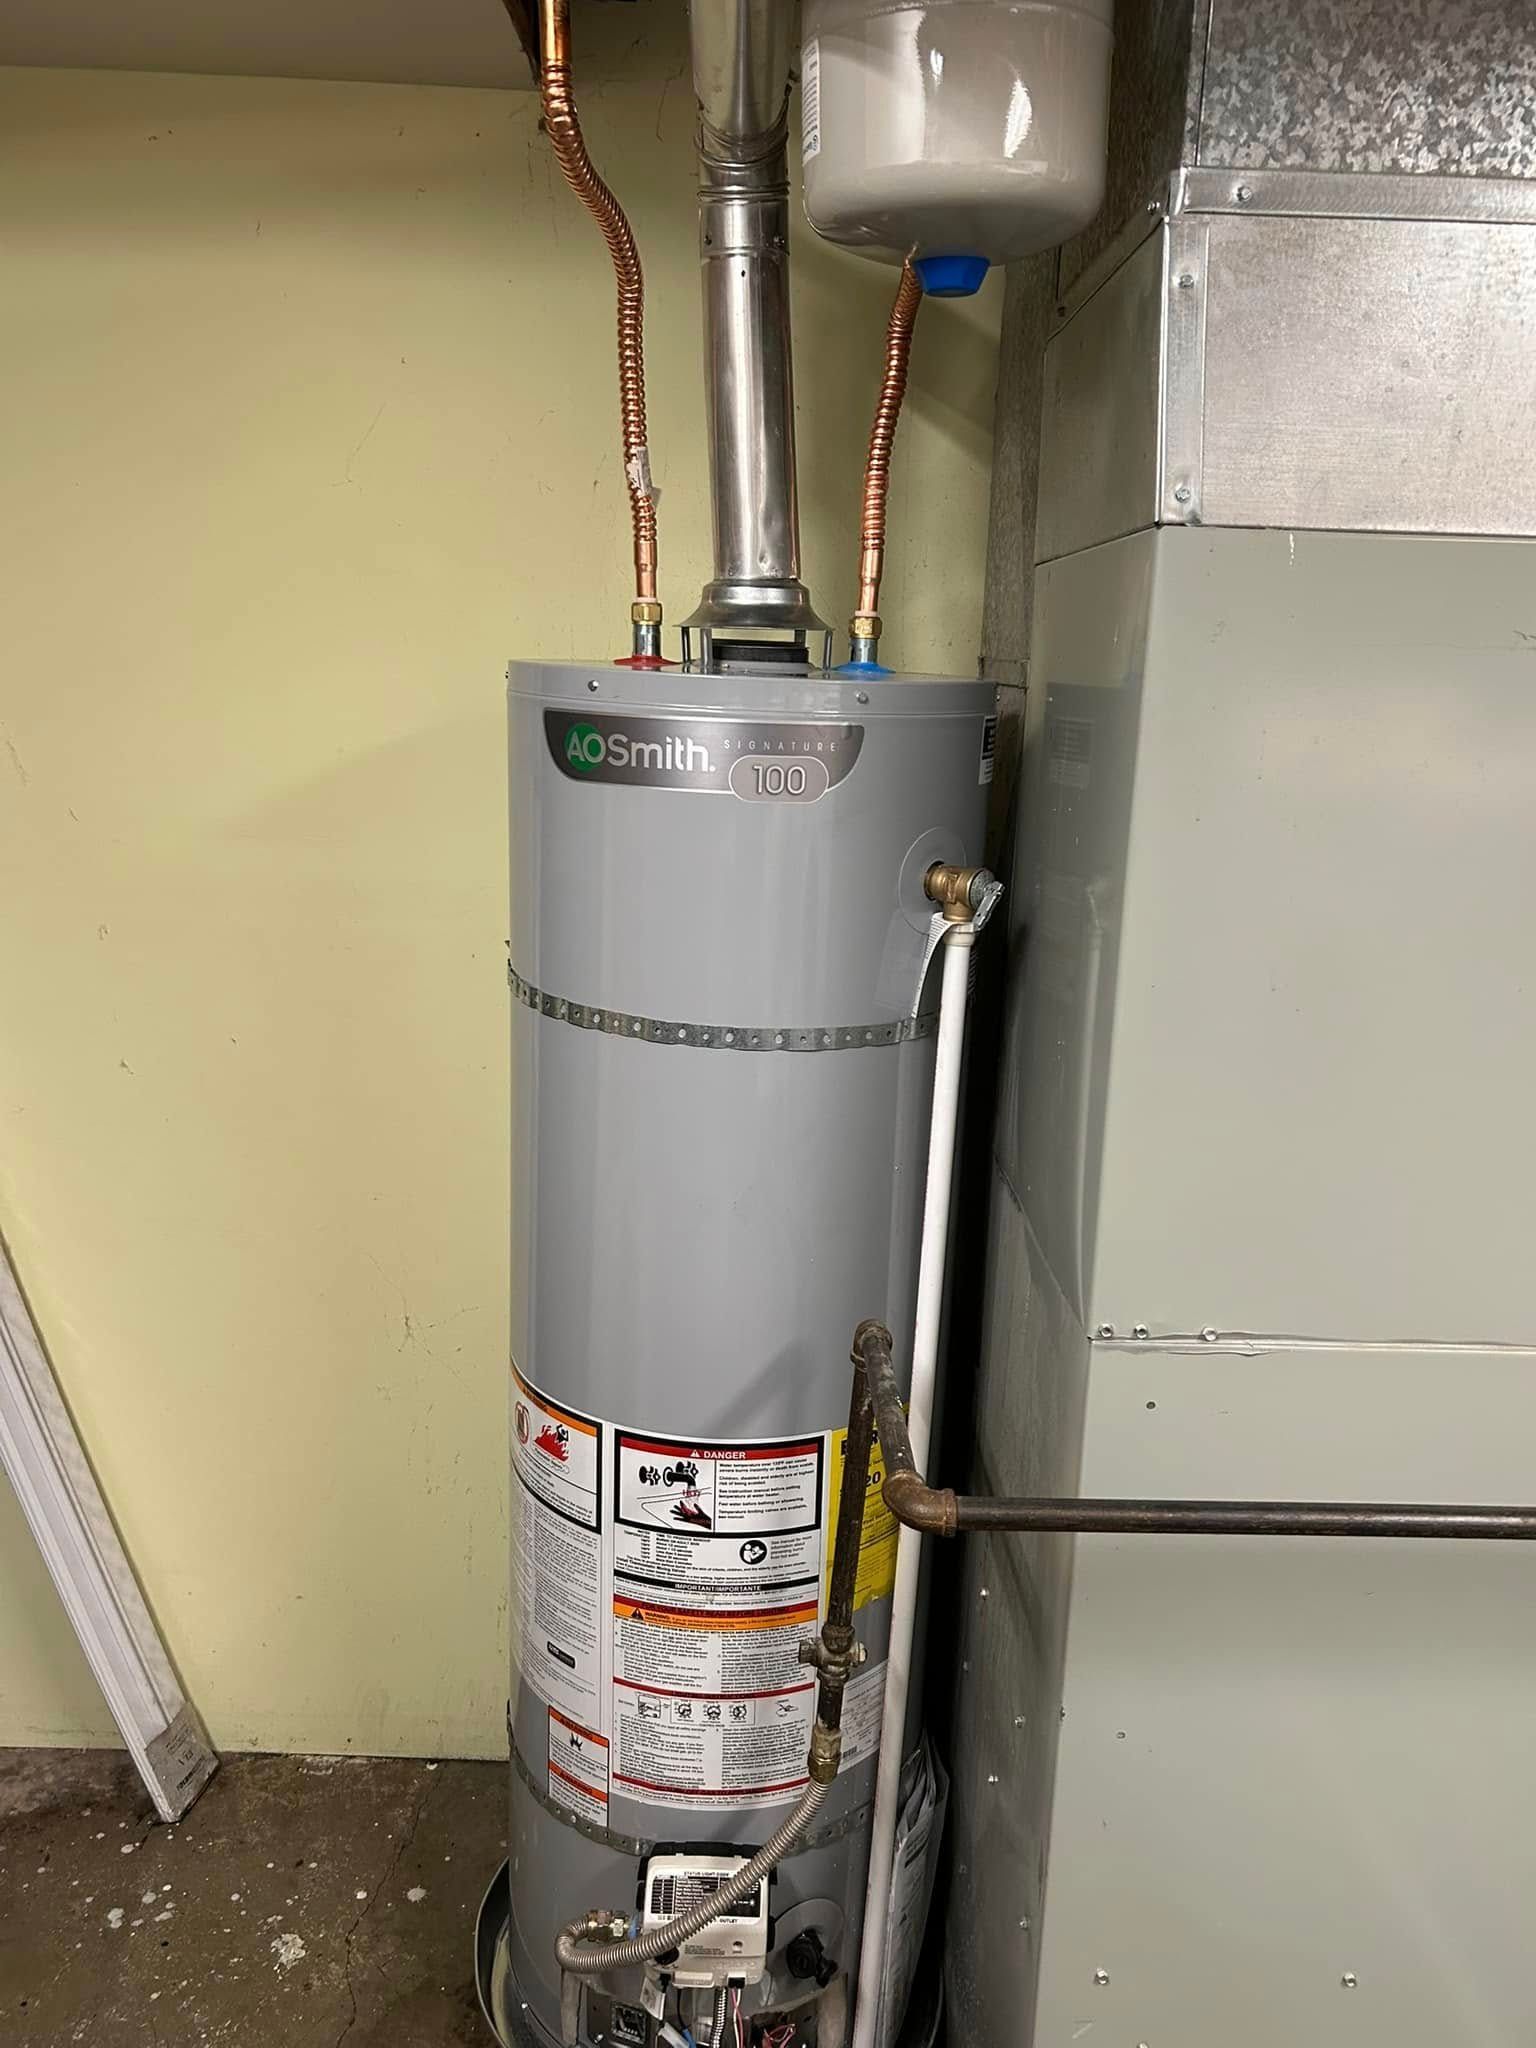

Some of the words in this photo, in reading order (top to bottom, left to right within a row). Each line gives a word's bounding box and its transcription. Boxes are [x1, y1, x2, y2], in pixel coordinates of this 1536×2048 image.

[724, 738, 838, 752] SIGNATURE
[752, 765, 806, 795] 100
[704, 1451, 746, 1459] DANGER
